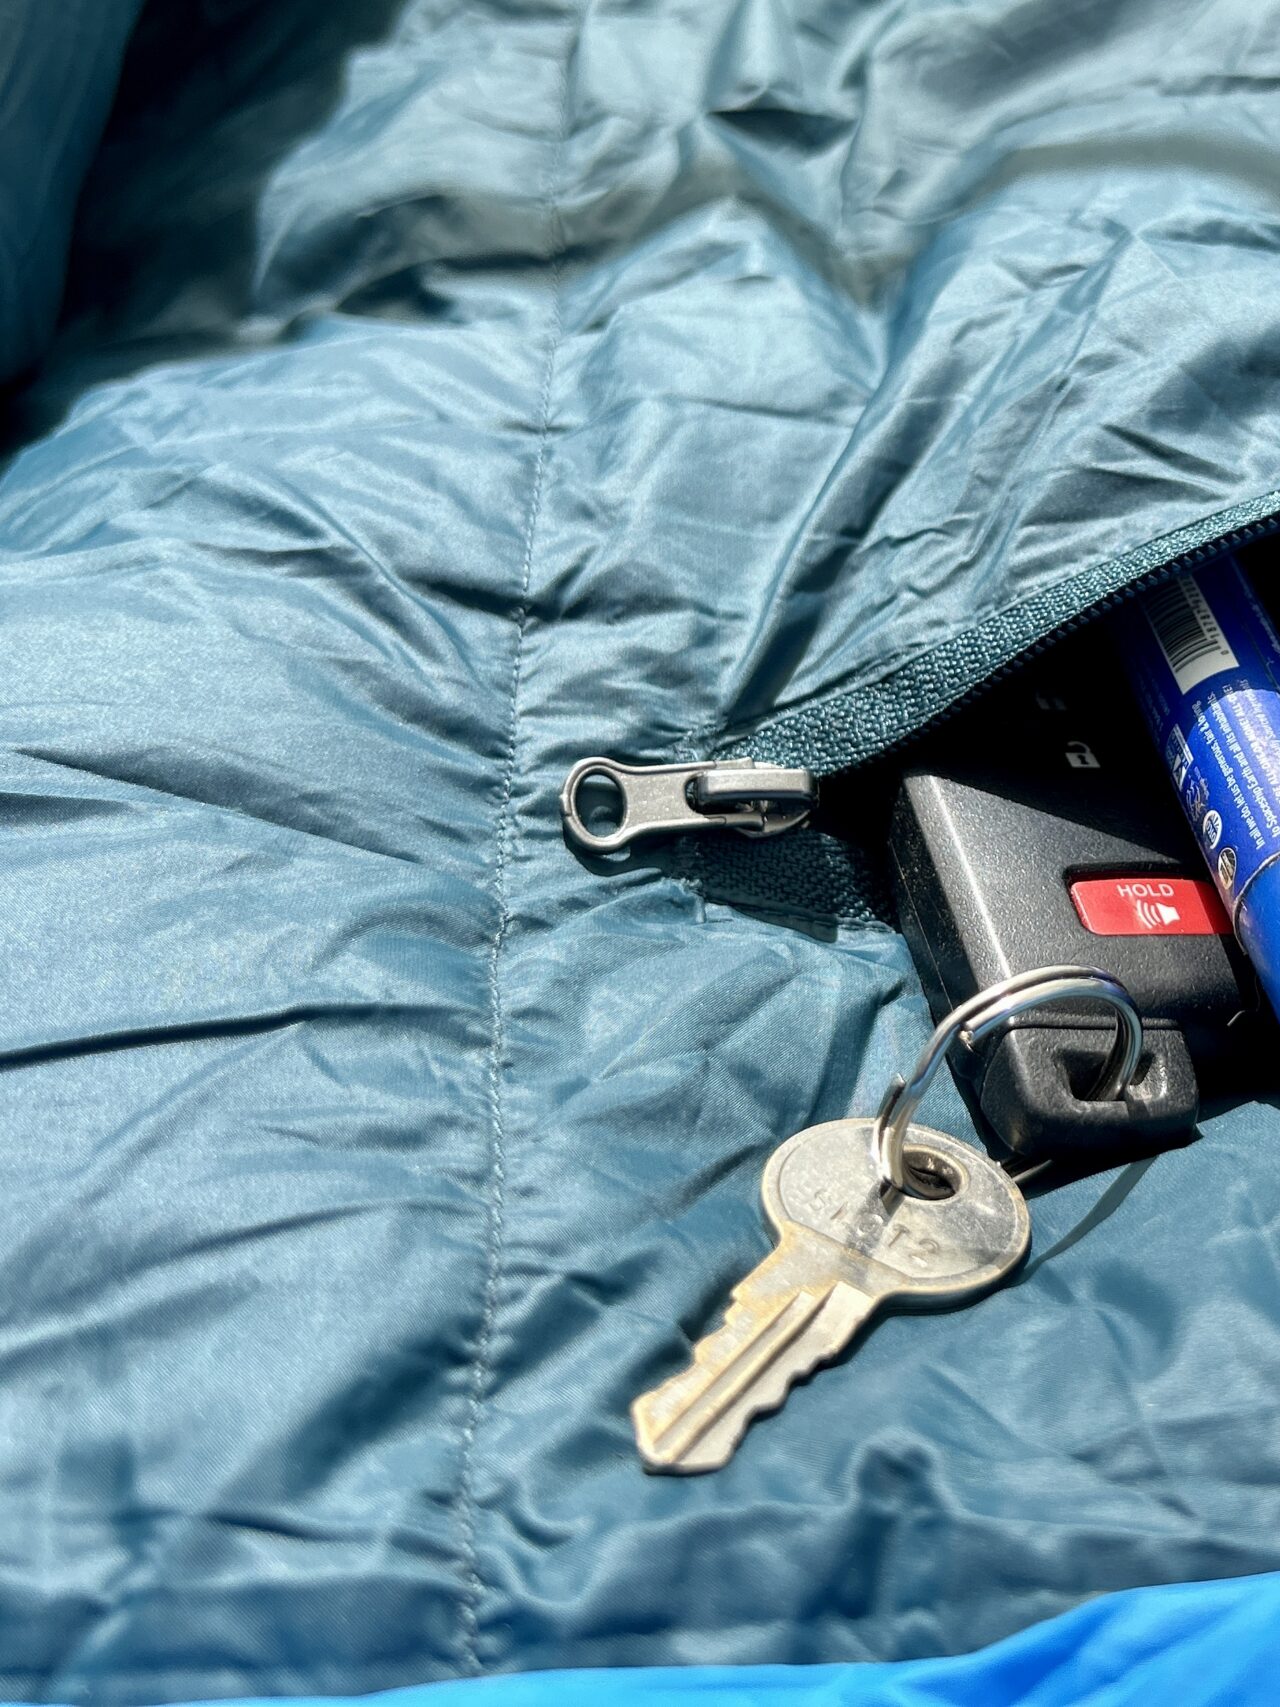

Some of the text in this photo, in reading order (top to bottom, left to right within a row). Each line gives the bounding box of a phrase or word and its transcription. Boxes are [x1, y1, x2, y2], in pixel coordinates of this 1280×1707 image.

[1207, 691, 1231, 734] inhabitants.
[1199, 721, 1210, 732] &
[1204, 729, 1215, 744] fair
[1226, 732, 1237, 744] its
[1229, 742, 1241, 753] all
[1207, 740, 1233, 776] generous,
[1233, 751, 1248, 767] and
[1226, 774, 1236, 788] be
[1241, 766, 1258, 789] Earth
[1230, 784, 1241, 796] us
[1233, 793, 1245, 808] let
[1252, 786, 1277, 828] Spaceship
[1236, 803, 1251, 818] do,
[1246, 816, 1256, 830] we
[1248, 827, 1261, 839] all
[1255, 836, 1266, 850] In
[1116, 883, 1174, 897] HOLD
